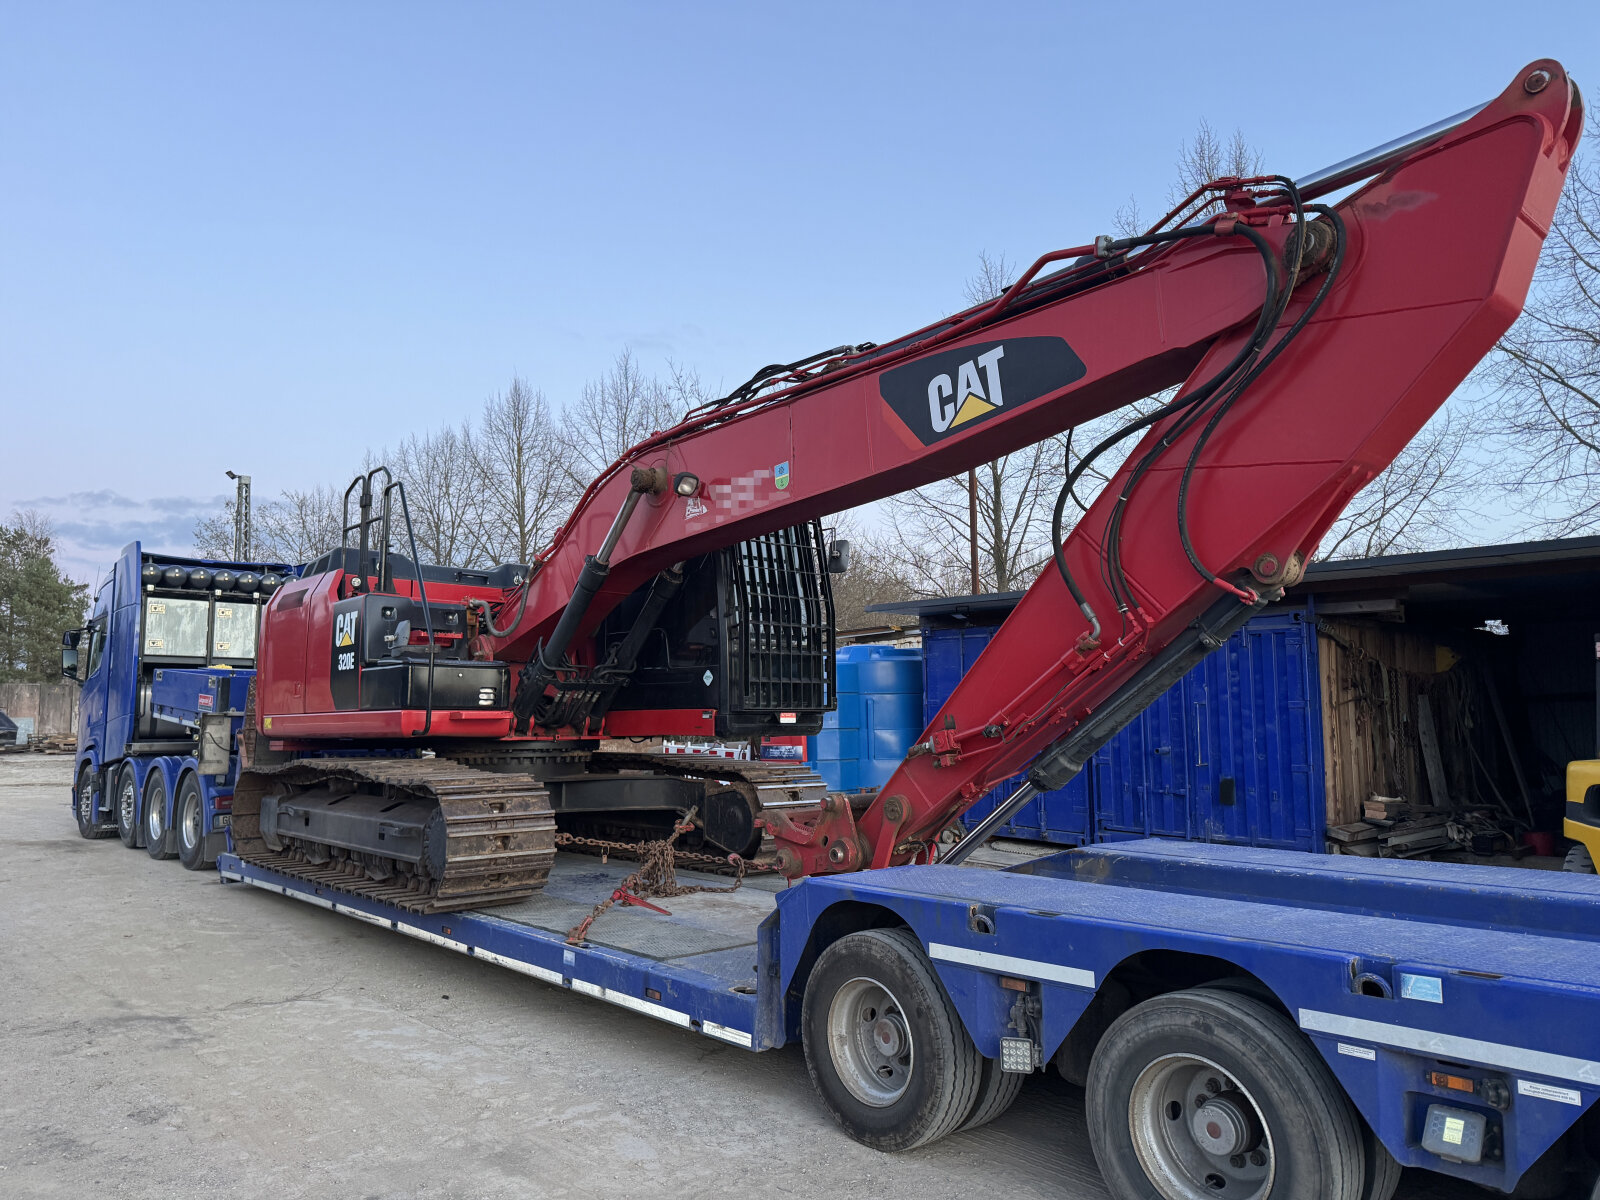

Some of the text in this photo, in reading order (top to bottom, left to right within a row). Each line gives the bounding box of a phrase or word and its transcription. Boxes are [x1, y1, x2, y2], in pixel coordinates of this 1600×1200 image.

[928, 345, 1004, 433] CAT
[336, 611, 358, 647] CAT
[338, 652, 355, 670] 320E
